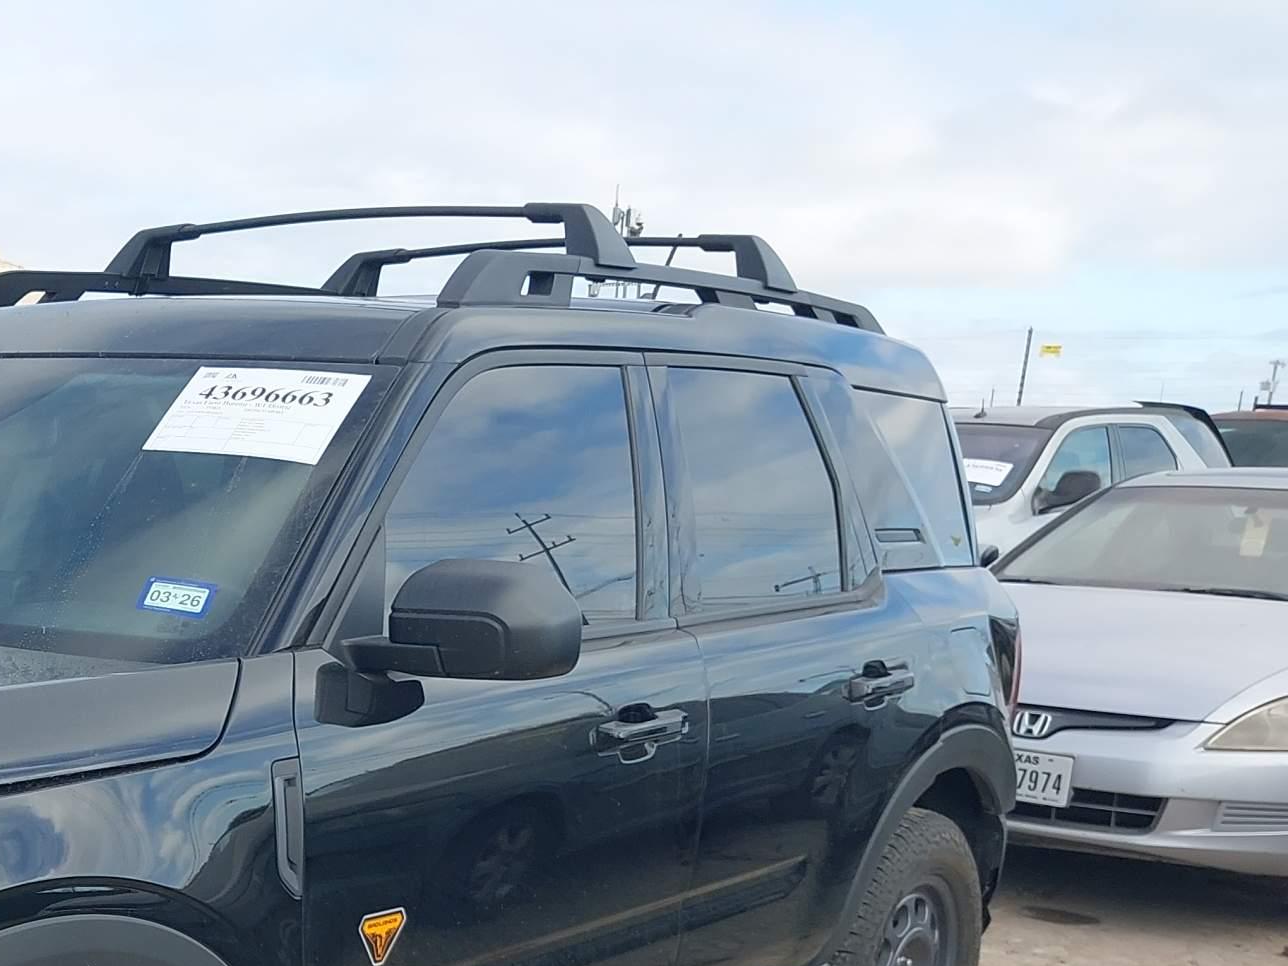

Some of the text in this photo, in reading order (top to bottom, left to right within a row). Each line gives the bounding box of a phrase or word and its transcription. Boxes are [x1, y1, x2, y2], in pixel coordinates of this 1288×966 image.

[199, 384, 334, 408] 43696663
[149, 589, 203, 608] 03 26
[1016, 768, 1063, 795] 7974
